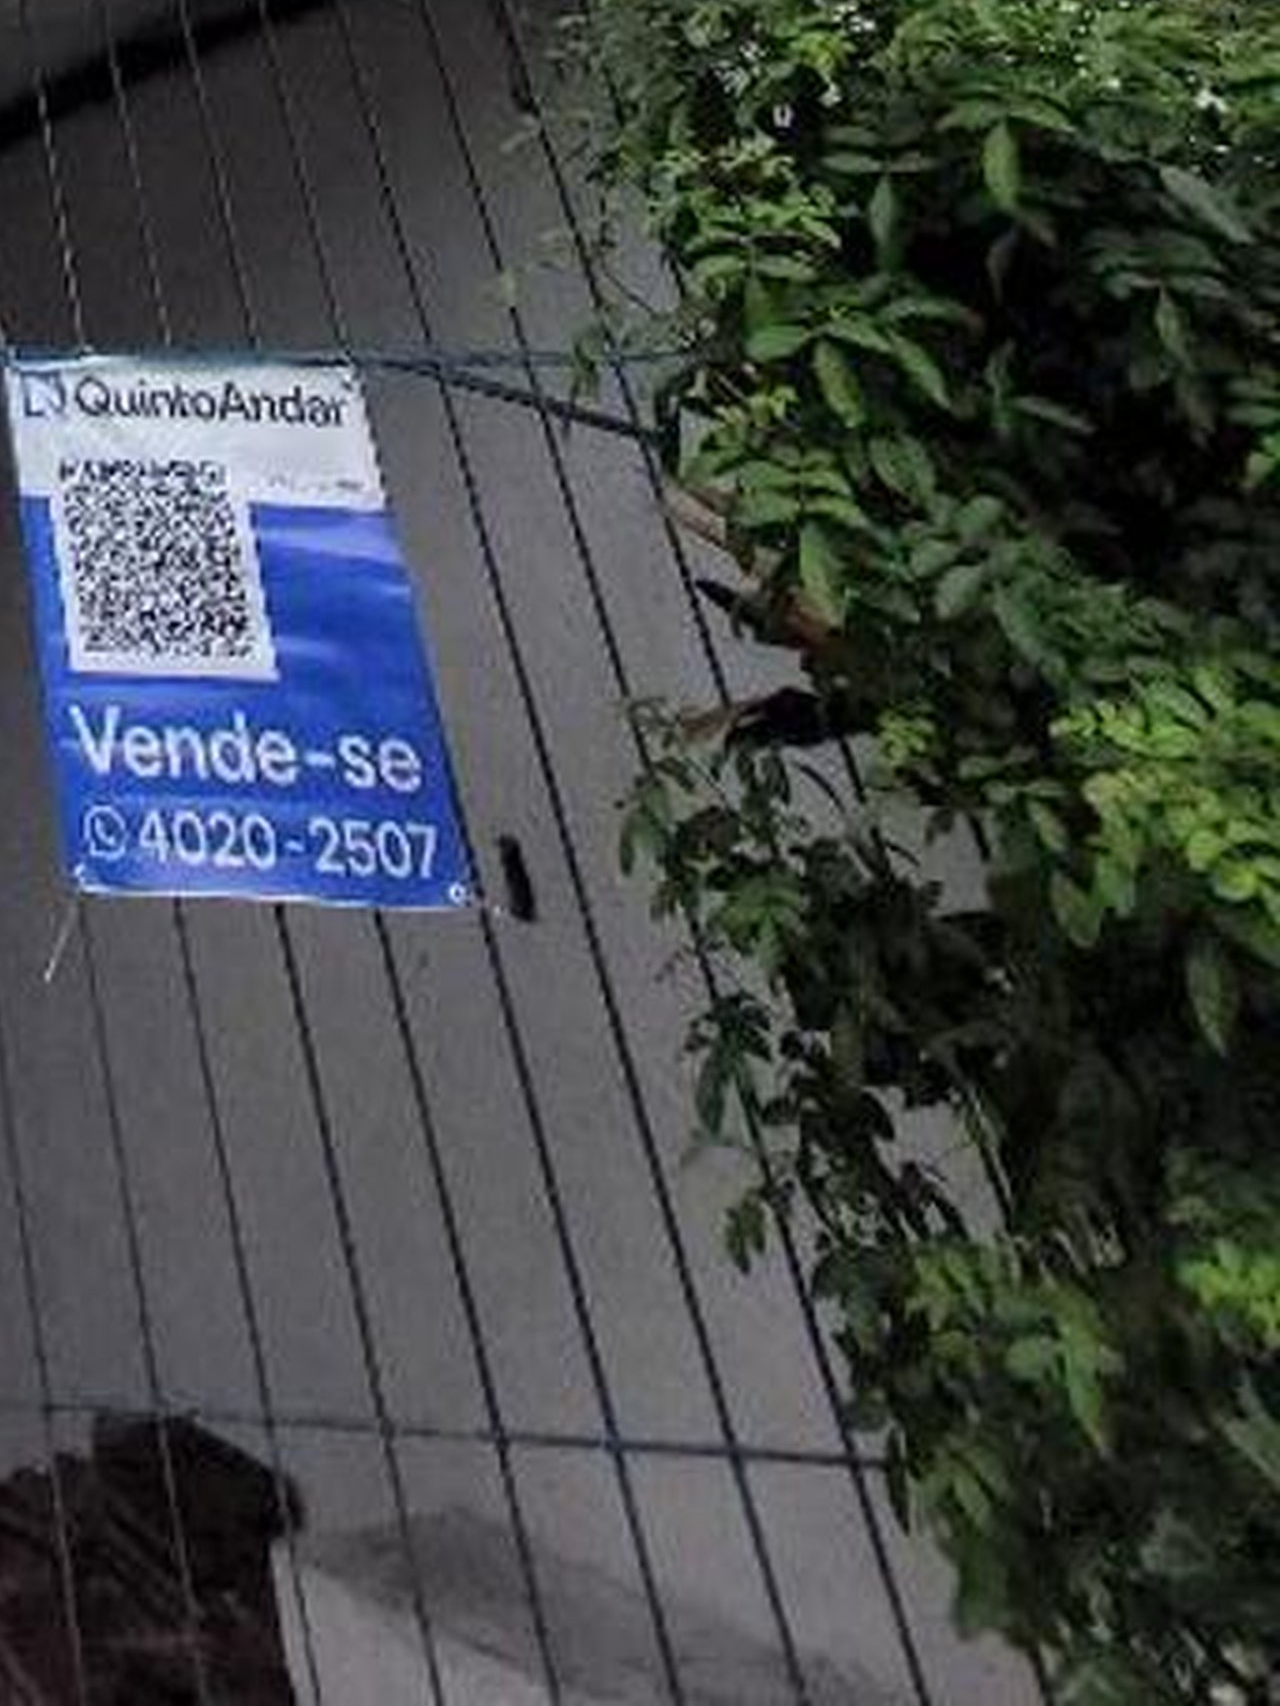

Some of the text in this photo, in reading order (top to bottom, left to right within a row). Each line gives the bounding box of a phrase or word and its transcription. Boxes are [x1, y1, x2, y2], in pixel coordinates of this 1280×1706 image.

[75, 375, 348, 428] QuintoAndar
[69, 703, 423, 793] Vende-se
[138, 807, 439, 880] 4020-2507
